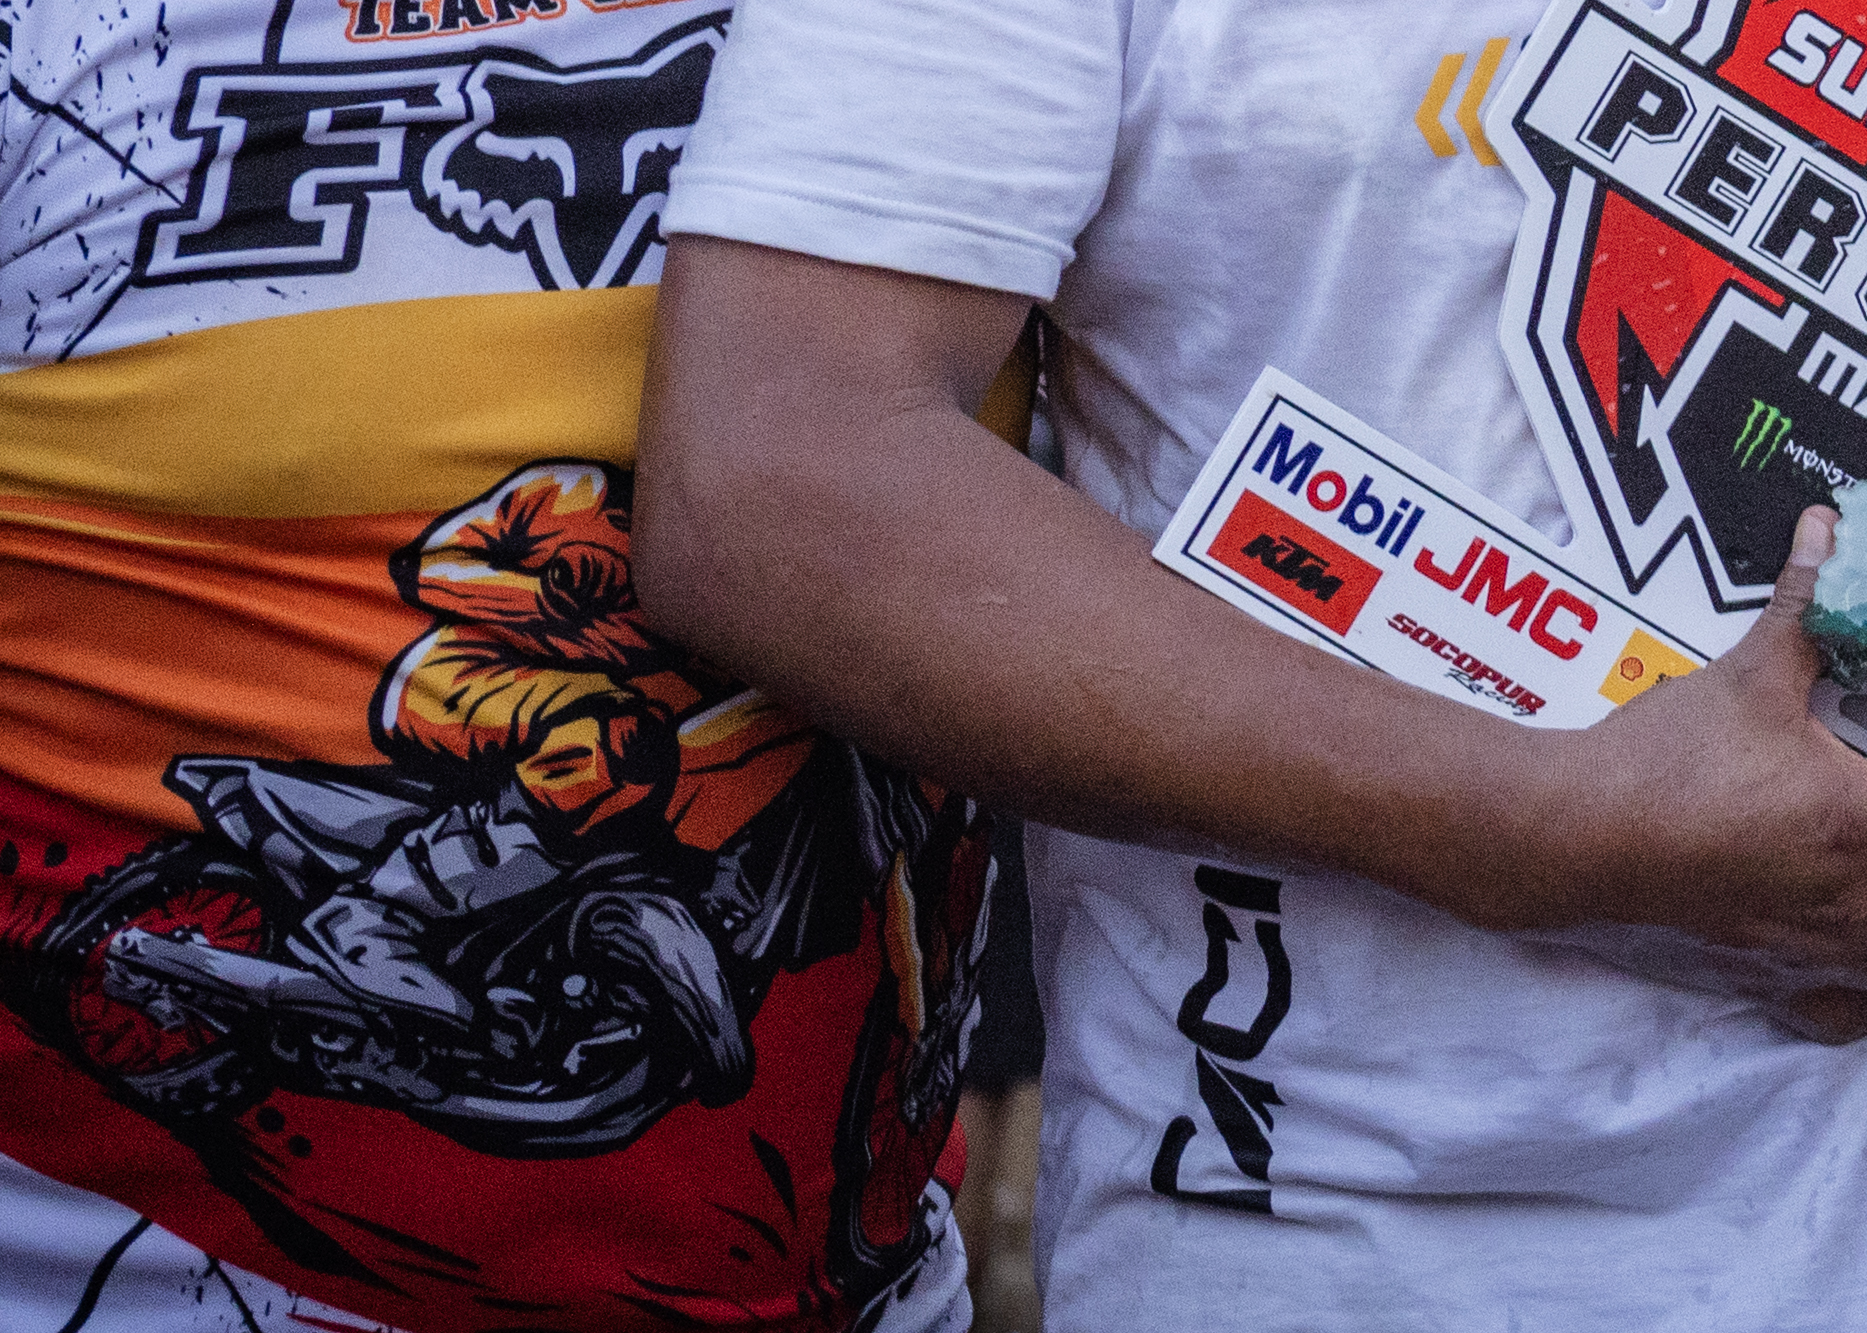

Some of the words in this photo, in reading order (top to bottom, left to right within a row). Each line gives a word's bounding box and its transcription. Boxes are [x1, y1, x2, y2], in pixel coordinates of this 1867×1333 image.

[1251, 422, 1426, 558] Mobil
[1241, 533, 1344, 602] KTM
[1412, 536, 1600, 661] JMC
[1384, 613, 1547, 714] SOCOPUR
